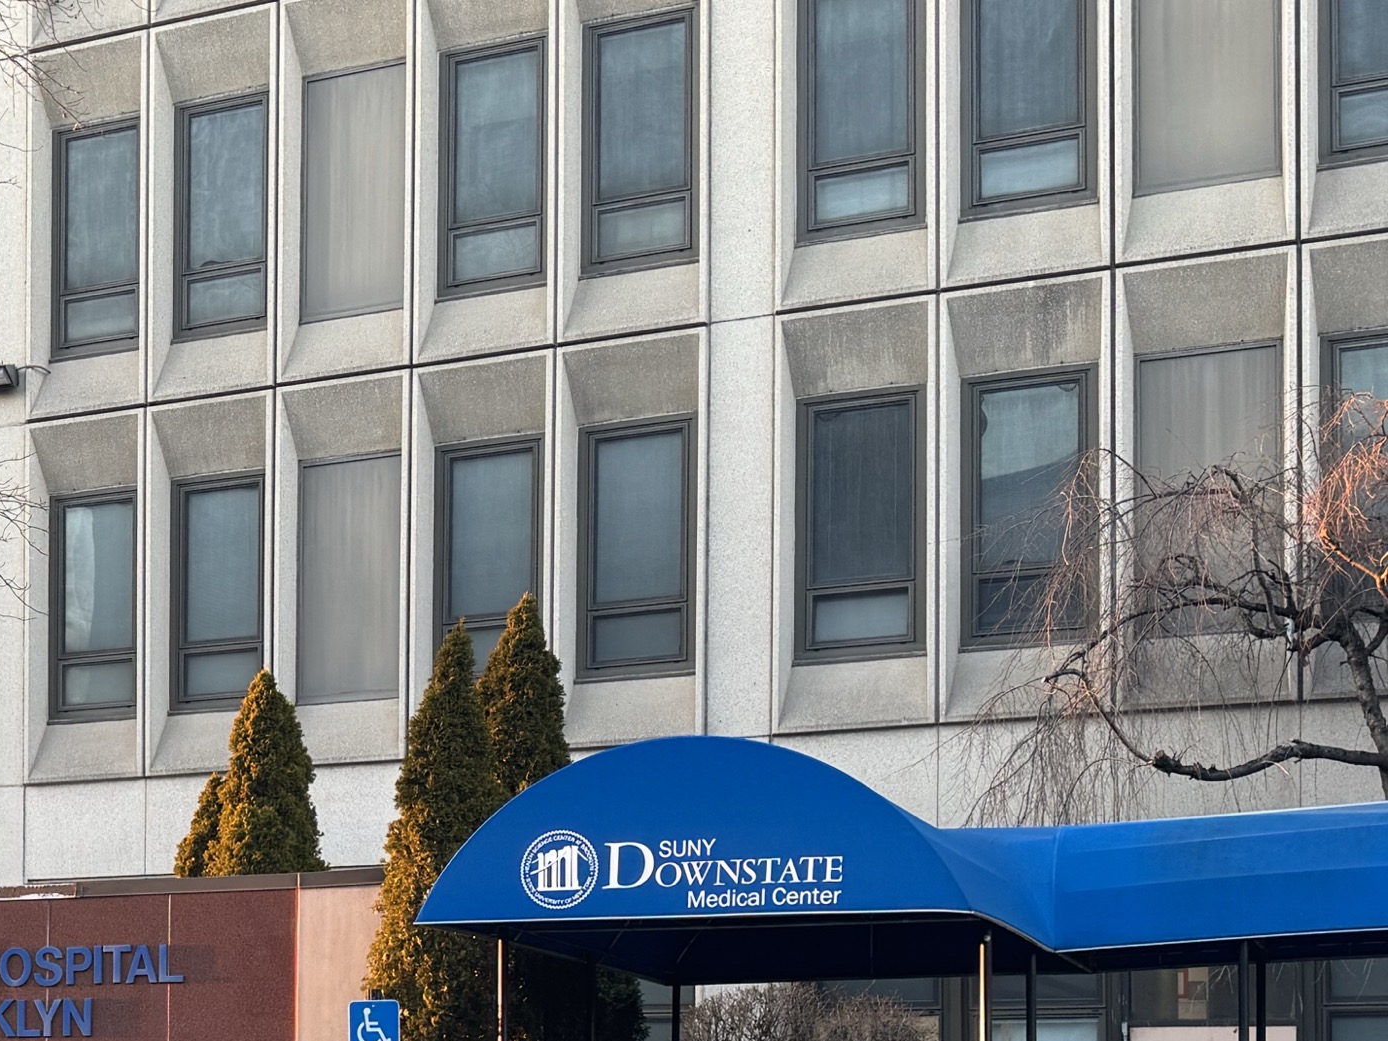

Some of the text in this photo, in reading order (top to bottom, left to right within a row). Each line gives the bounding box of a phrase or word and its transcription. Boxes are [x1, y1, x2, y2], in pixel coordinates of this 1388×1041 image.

[553, 834, 575, 842] CENTER
[658, 838, 716, 858] SUNY
[687, 886, 842, 909] Medical Center
